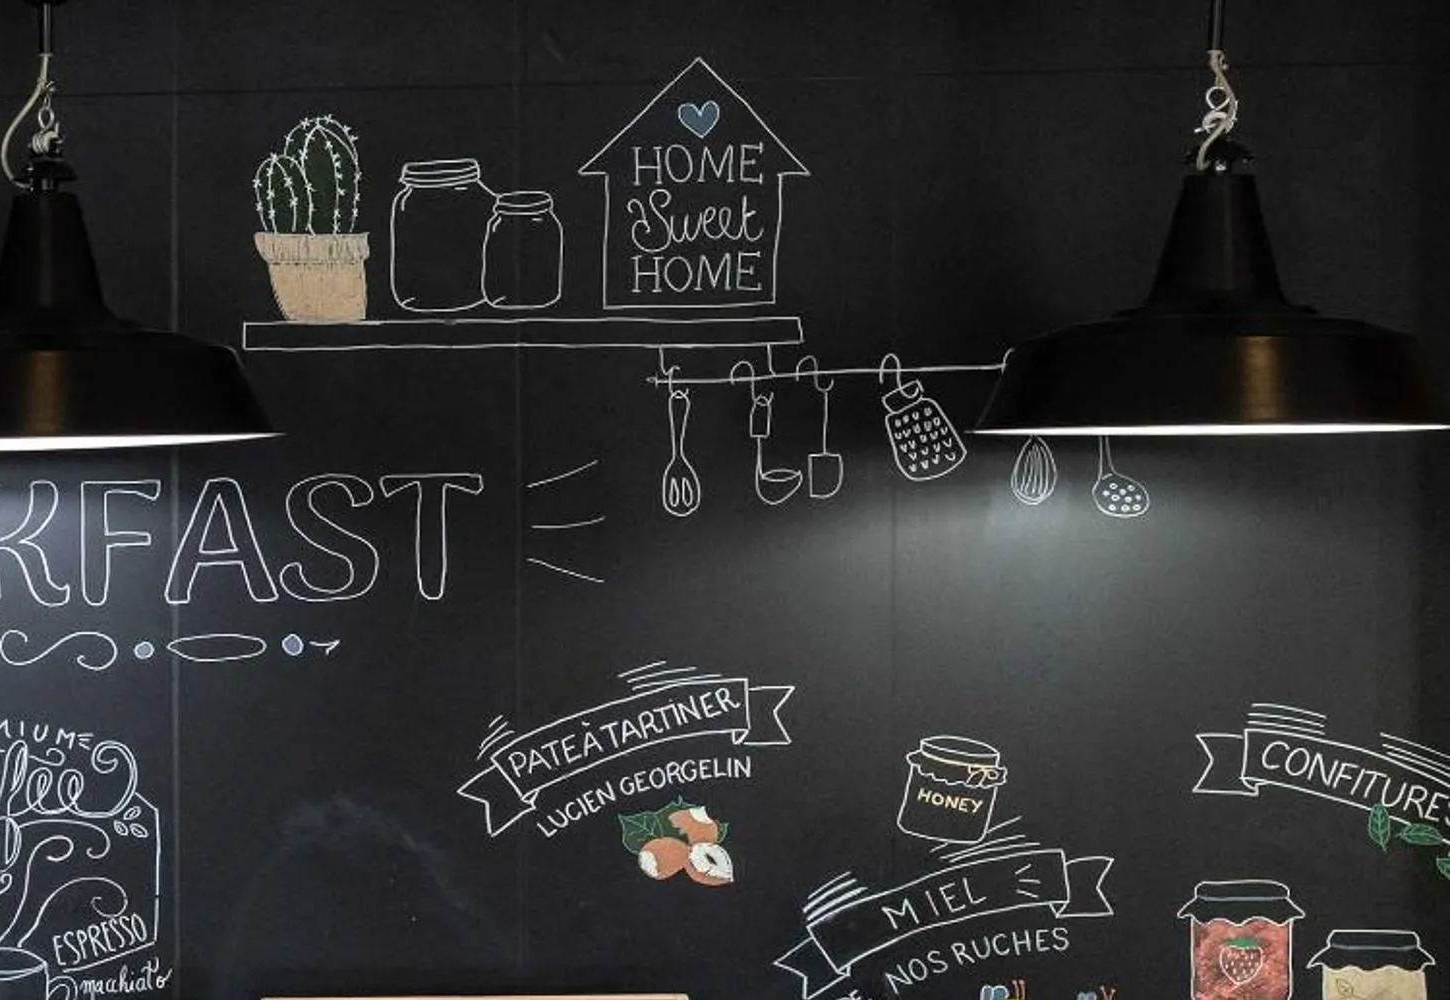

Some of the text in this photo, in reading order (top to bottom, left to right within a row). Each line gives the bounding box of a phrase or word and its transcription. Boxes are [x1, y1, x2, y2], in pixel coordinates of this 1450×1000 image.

[633, 142, 763, 185] HOME
[627, 189, 764, 253] Sweet
[632, 251, 762, 293] HOME
[537, 756, 751, 838] LUCIEN GEORGELIN
[917, 788, 984, 814] HONEY
[1261, 740, 1450, 826] CONFITURE
[881, 877, 987, 930] MIEL
[52, 912, 147, 966] ESPRESSO
[885, 950, 948, 995] NOS
[950, 927, 1070, 966] RUCHES
